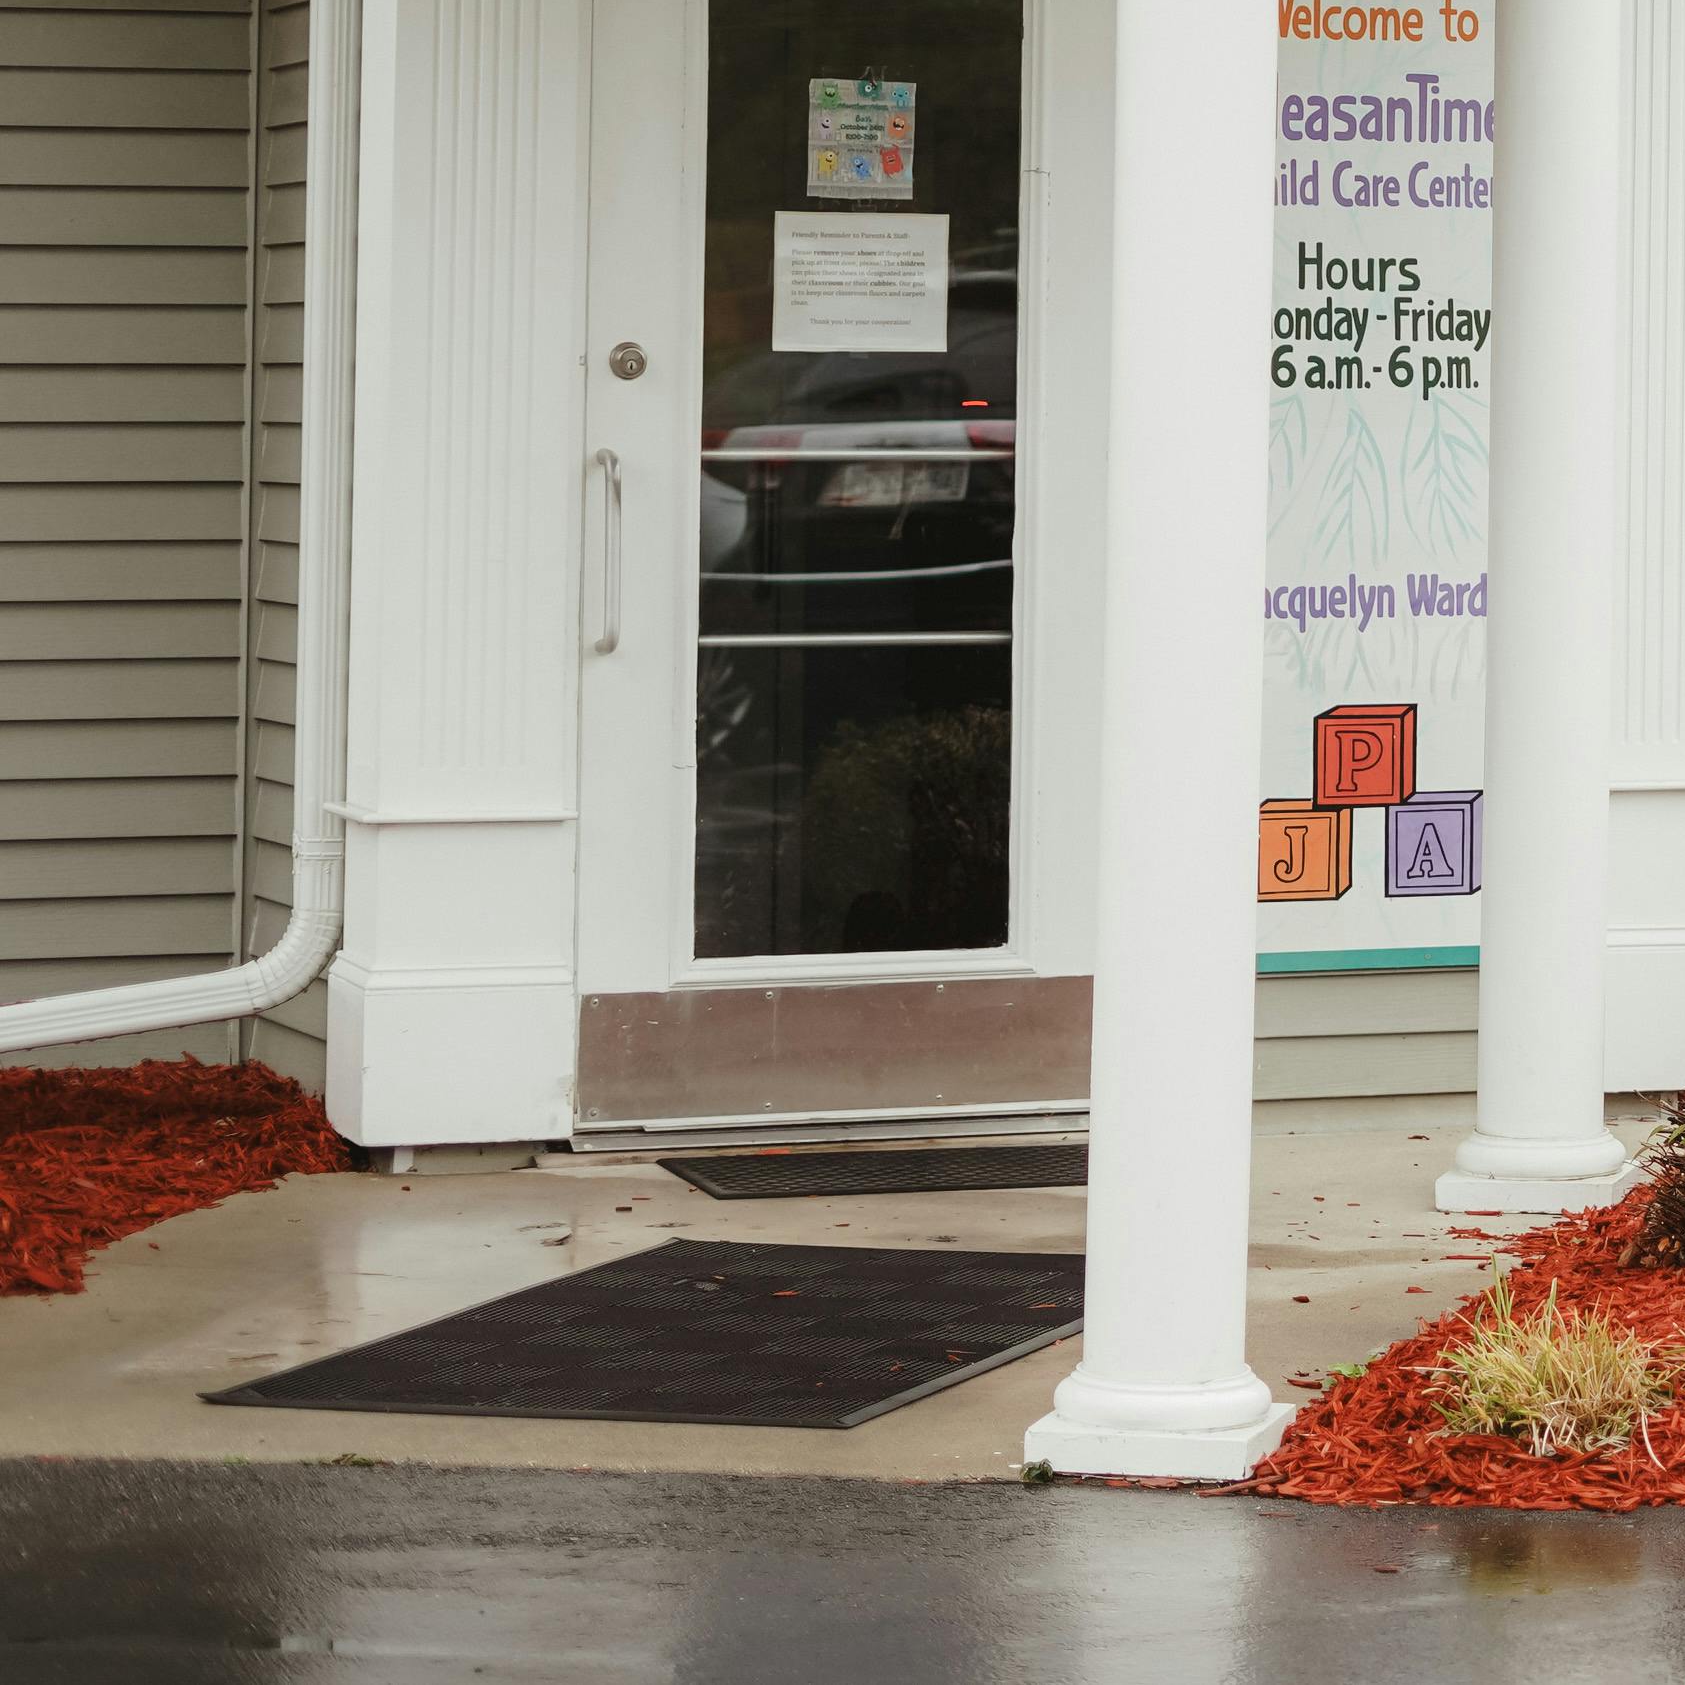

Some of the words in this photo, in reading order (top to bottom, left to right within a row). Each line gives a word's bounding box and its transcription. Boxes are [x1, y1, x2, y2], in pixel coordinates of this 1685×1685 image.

[1276, 73, 1495, 144] easanTim
[1274, 159, 1319, 207] ild
[1332, 160, 1401, 208] Care
[1408, 161, 1494, 209] Cente
[791, 231, 819, 240] Friendly
[820, 231, 852, 239] Reminder
[1298, 241, 1421, 292] Hours
[1271, 344, 1297, 388] 6
[1422, 356, 1480, 401] p.m.
[1264, 573, 1395, 633] cquelyn
[1334, 729, 1384, 794] P
[1272, 824, 1310, 884] J
[1406, 822, 1456, 881] A
